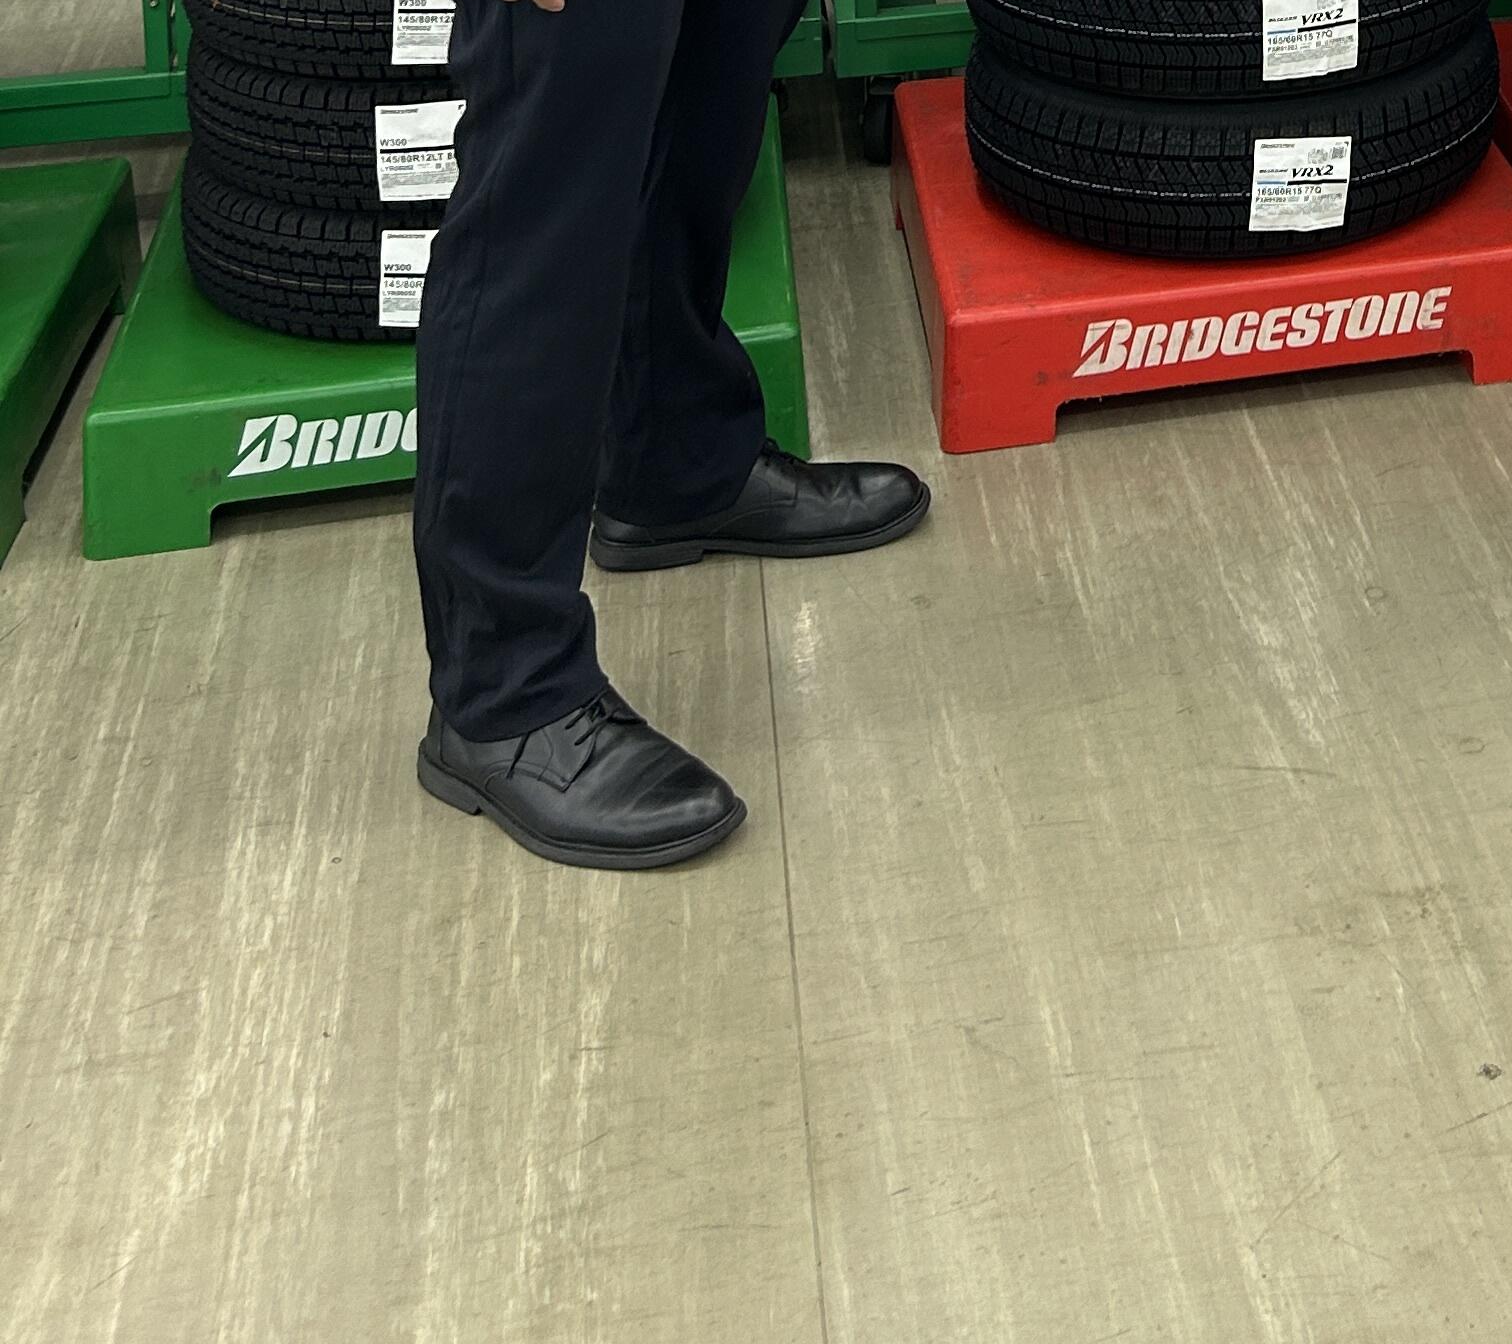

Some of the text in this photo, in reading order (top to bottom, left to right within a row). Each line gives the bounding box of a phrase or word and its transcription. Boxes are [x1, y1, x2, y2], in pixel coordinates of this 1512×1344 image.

[1301, 7, 1344, 26] VRX2
[380, 138, 407, 147] W300
[1292, 164, 1334, 178] VRX2
[384, 263, 412, 272] W300
[1073, 287, 1452, 379] BRIDGESTONE
